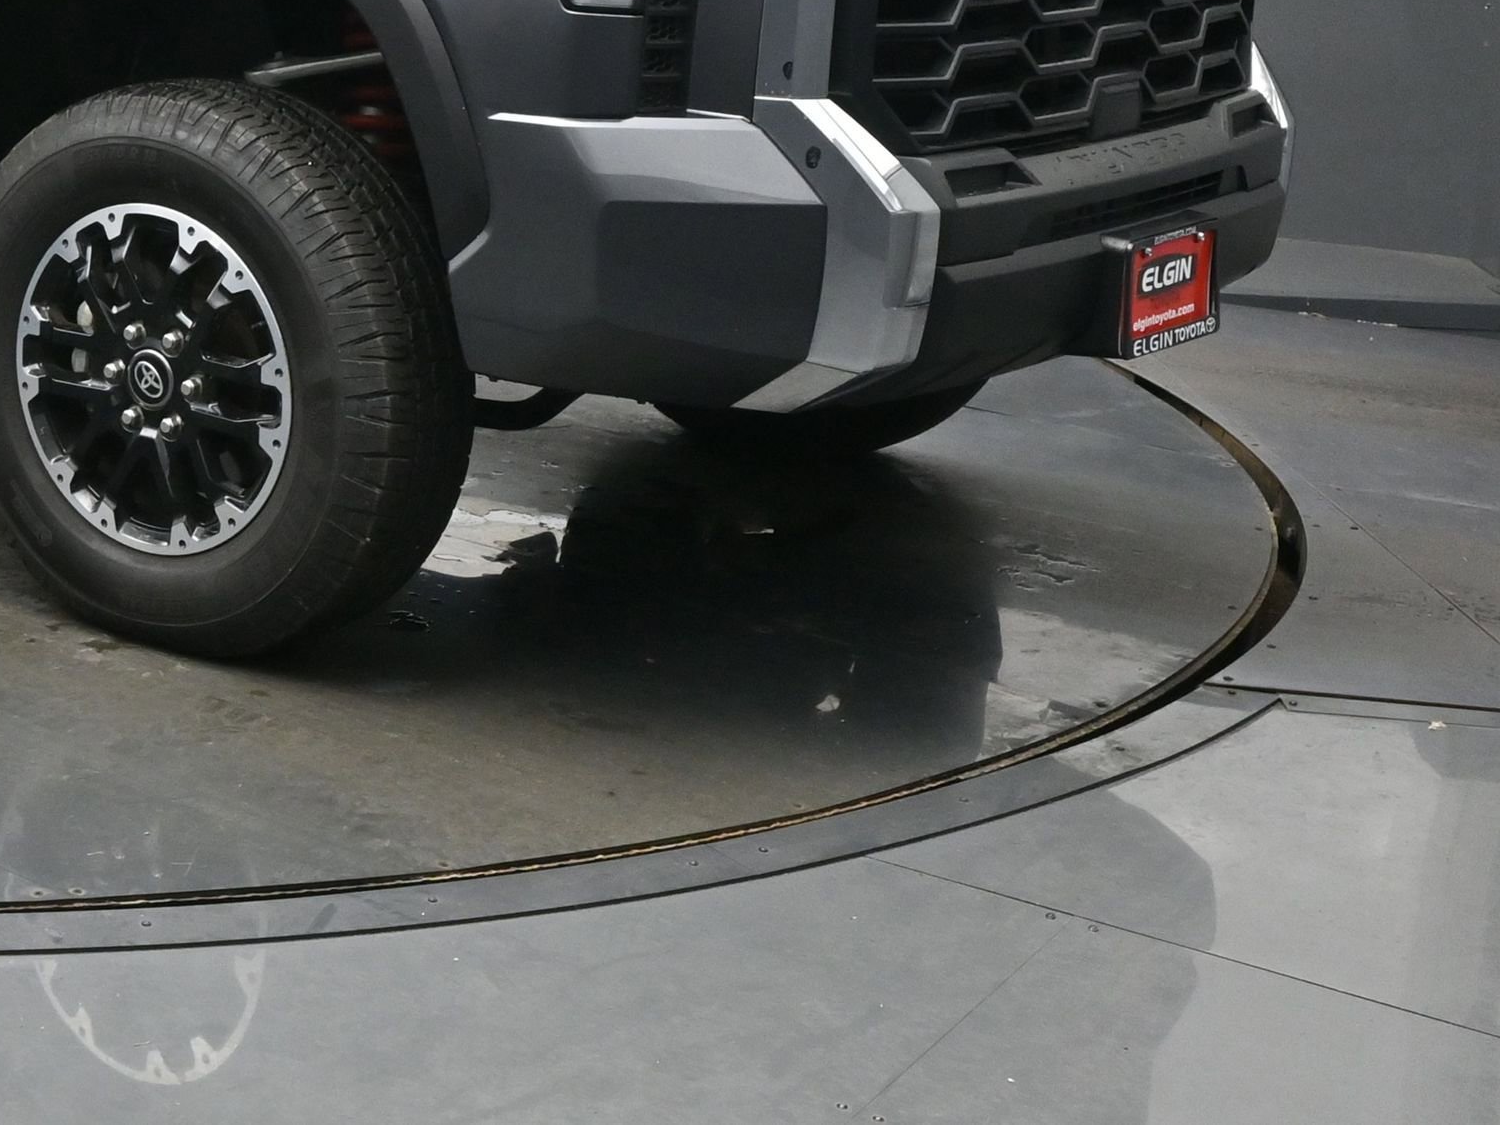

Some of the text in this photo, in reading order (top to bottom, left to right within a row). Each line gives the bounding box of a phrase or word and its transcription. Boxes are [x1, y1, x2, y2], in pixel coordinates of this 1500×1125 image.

[1142, 256, 1193, 293] ELGIN
[1132, 303, 1195, 332] elgintoyota.com
[1132, 322, 1206, 357] ELGIN TOYOTA
